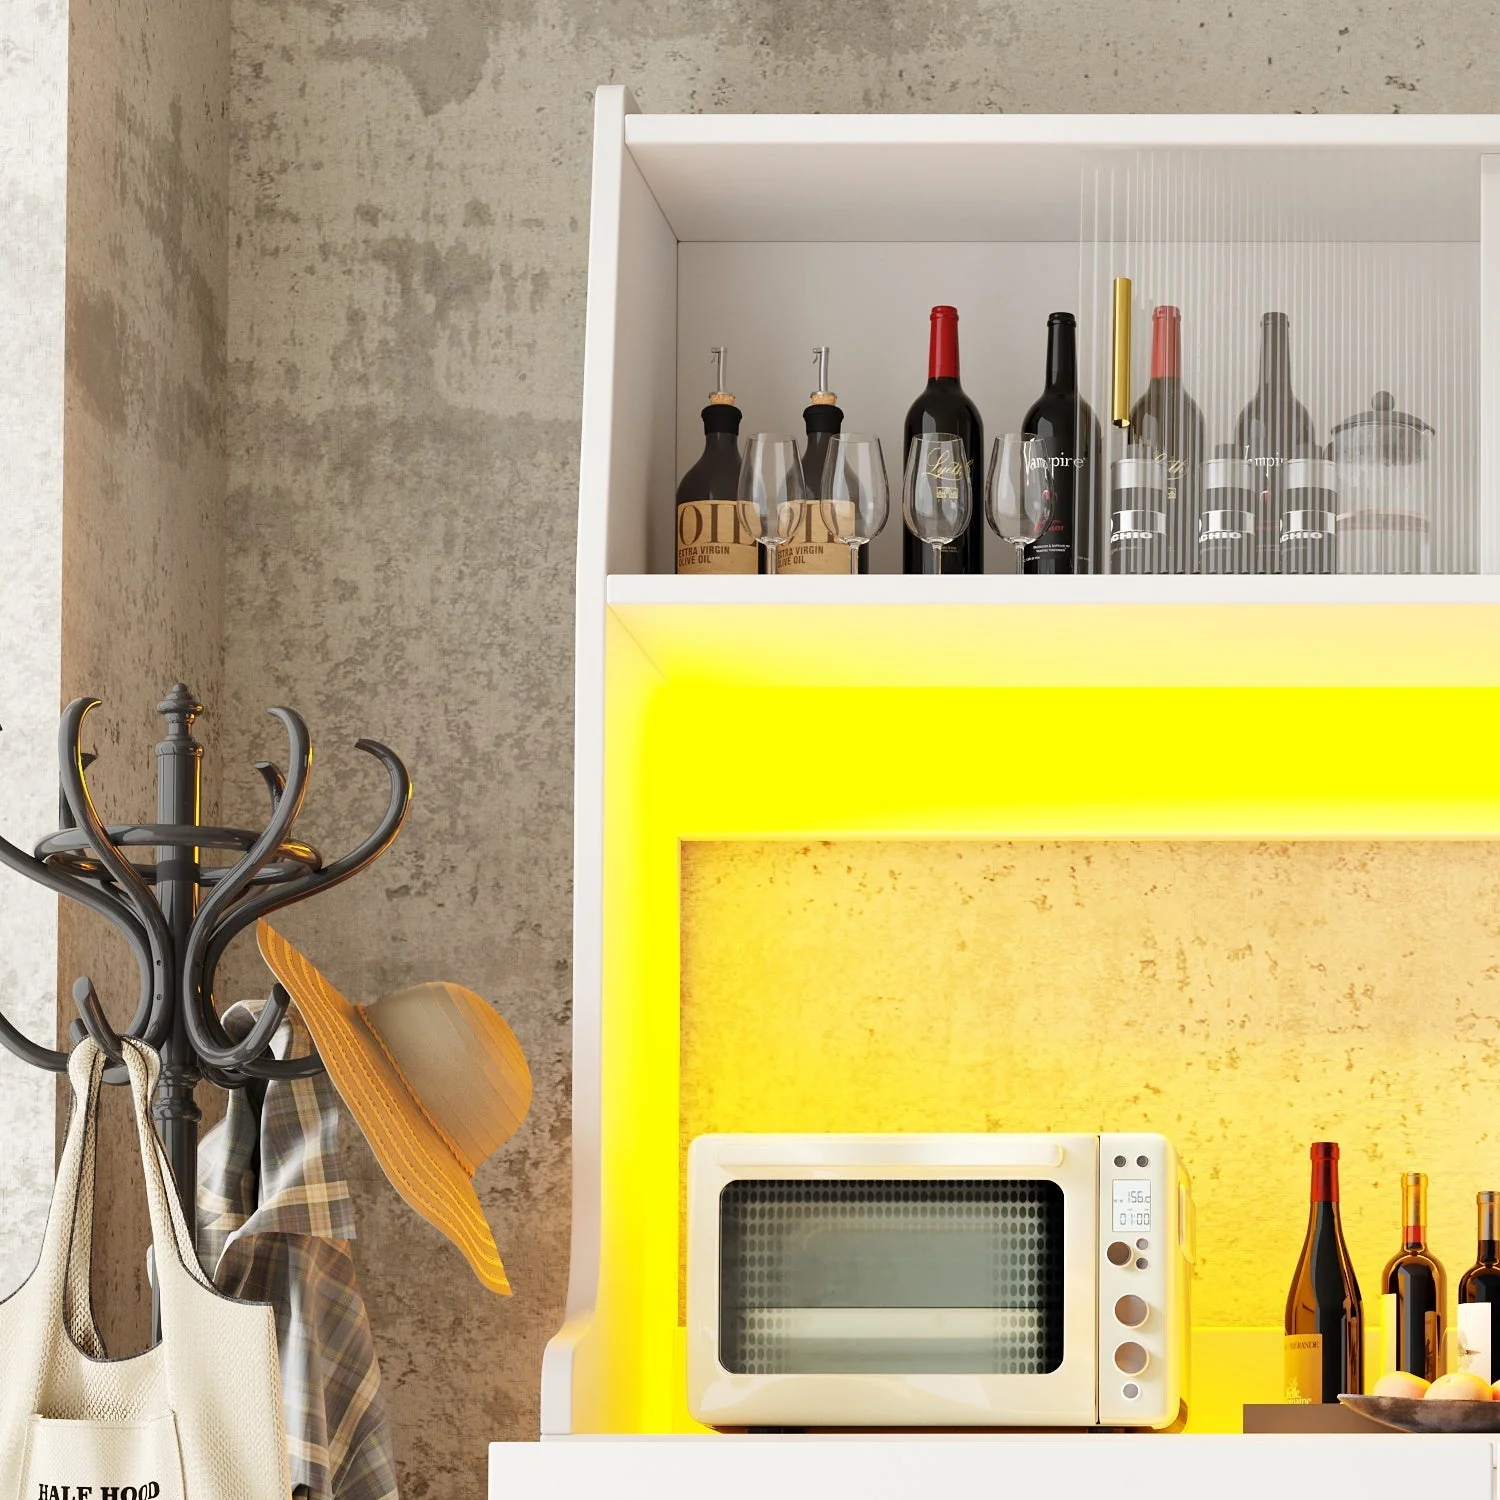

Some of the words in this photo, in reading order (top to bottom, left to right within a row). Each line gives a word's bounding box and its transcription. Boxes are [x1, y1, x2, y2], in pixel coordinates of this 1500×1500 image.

[678, 546, 698, 558] EXTRA
[700, 545, 730, 555] VIRGIN
[795, 545, 824, 556] VIRGIN
[678, 556, 696, 567] OLIVE
[697, 555, 712, 564] OIL
[793, 555, 806, 565] OIL
